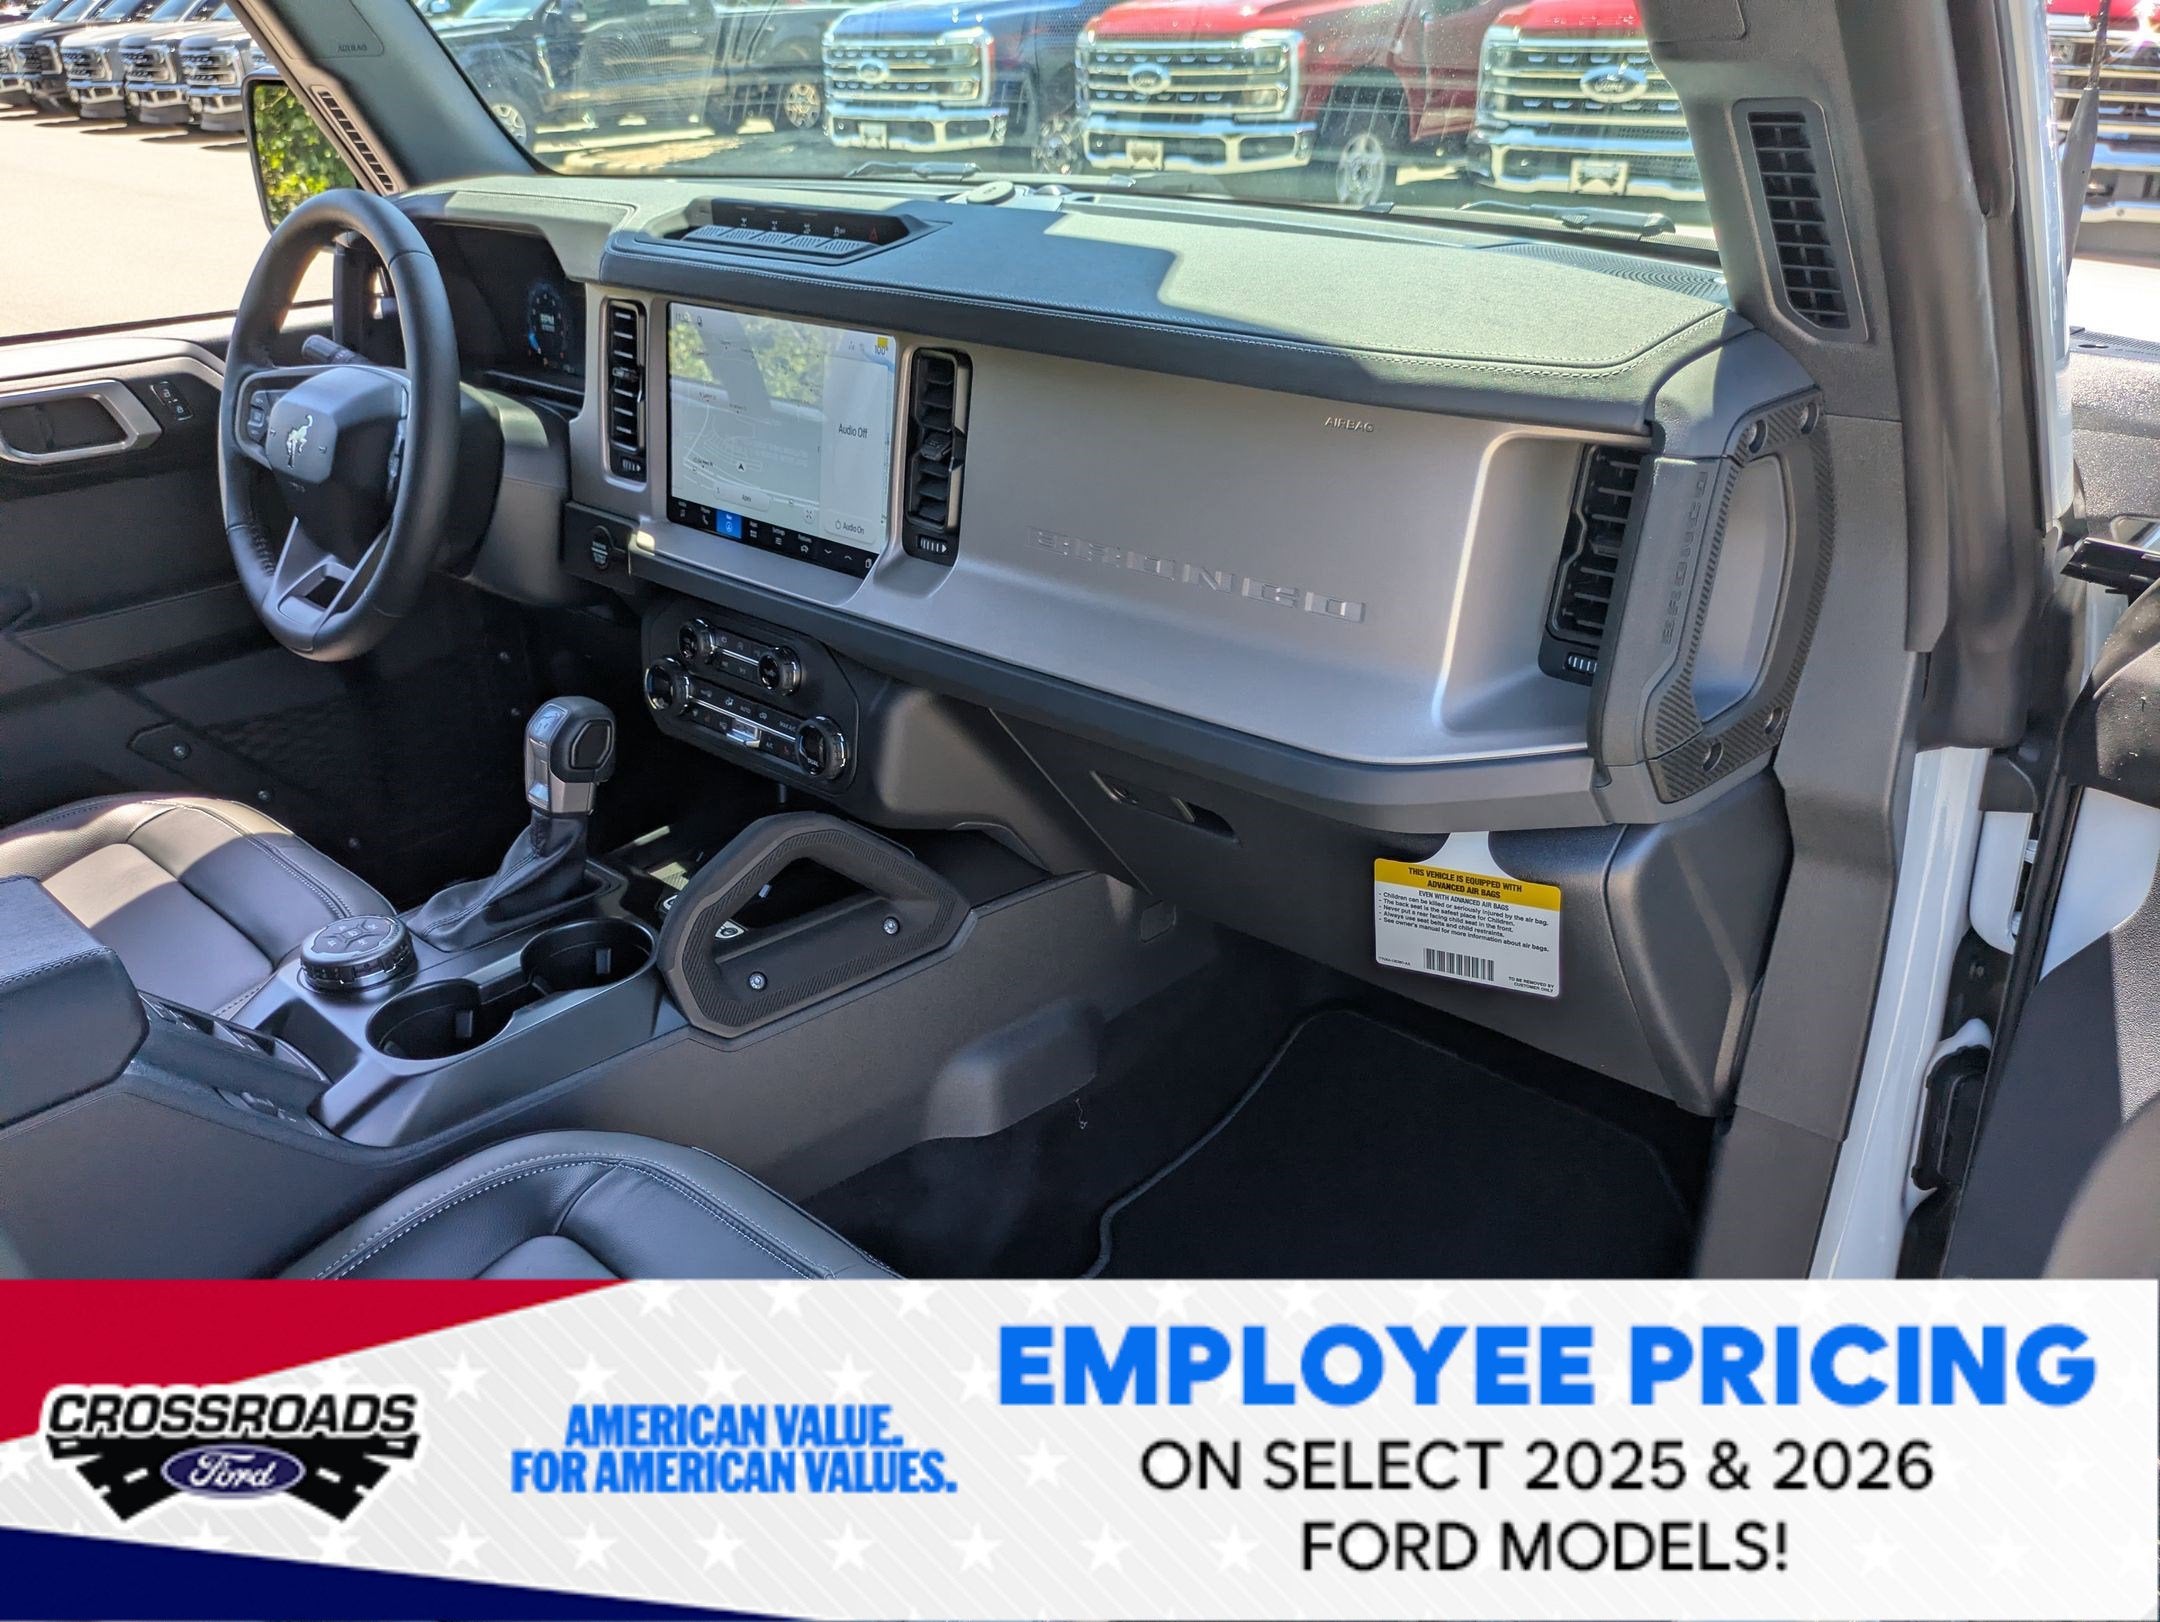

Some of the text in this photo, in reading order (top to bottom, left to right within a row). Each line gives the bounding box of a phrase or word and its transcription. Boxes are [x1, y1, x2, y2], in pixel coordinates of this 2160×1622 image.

[838, 423, 868, 438] Audio Off
[1324, 416, 1375, 432] AIRBAG
[842, 521, 865, 535] Audio On
[1408, 866, 1522, 892] THIS VEHICLE IS EQUIPPED WITH
[1427, 880, 1501, 898] ADVANCED AIR BAGS
[1383, 892, 1408, 901] Children
[1429, 900, 1445, 908] killed
[1454, 904, 1481, 914] seriously
[1482, 909, 1504, 918] injured
[1504, 913, 1513, 921] by
[1384, 898, 1395, 906] The
[1395, 900, 1410, 908] back
[1441, 908, 1459, 917] safest
[1459, 911, 1476, 919] place
[1418, 890, 1509, 911] EVEN WITH ADVANCED AIR BAGS
[1383, 911, 1404, 920] Always
[1430, 918, 1445, 926] belts
[1458, 923, 1473, 931] child
[1401, 908, 1411, 916] put
[1429, 911, 1448, 922] facing
[1448, 916, 1464, 924] child
[1418, 924, 1441, 932] manual
[1467, 932, 1503, 944] information
[1503, 939, 1522, 947] about
